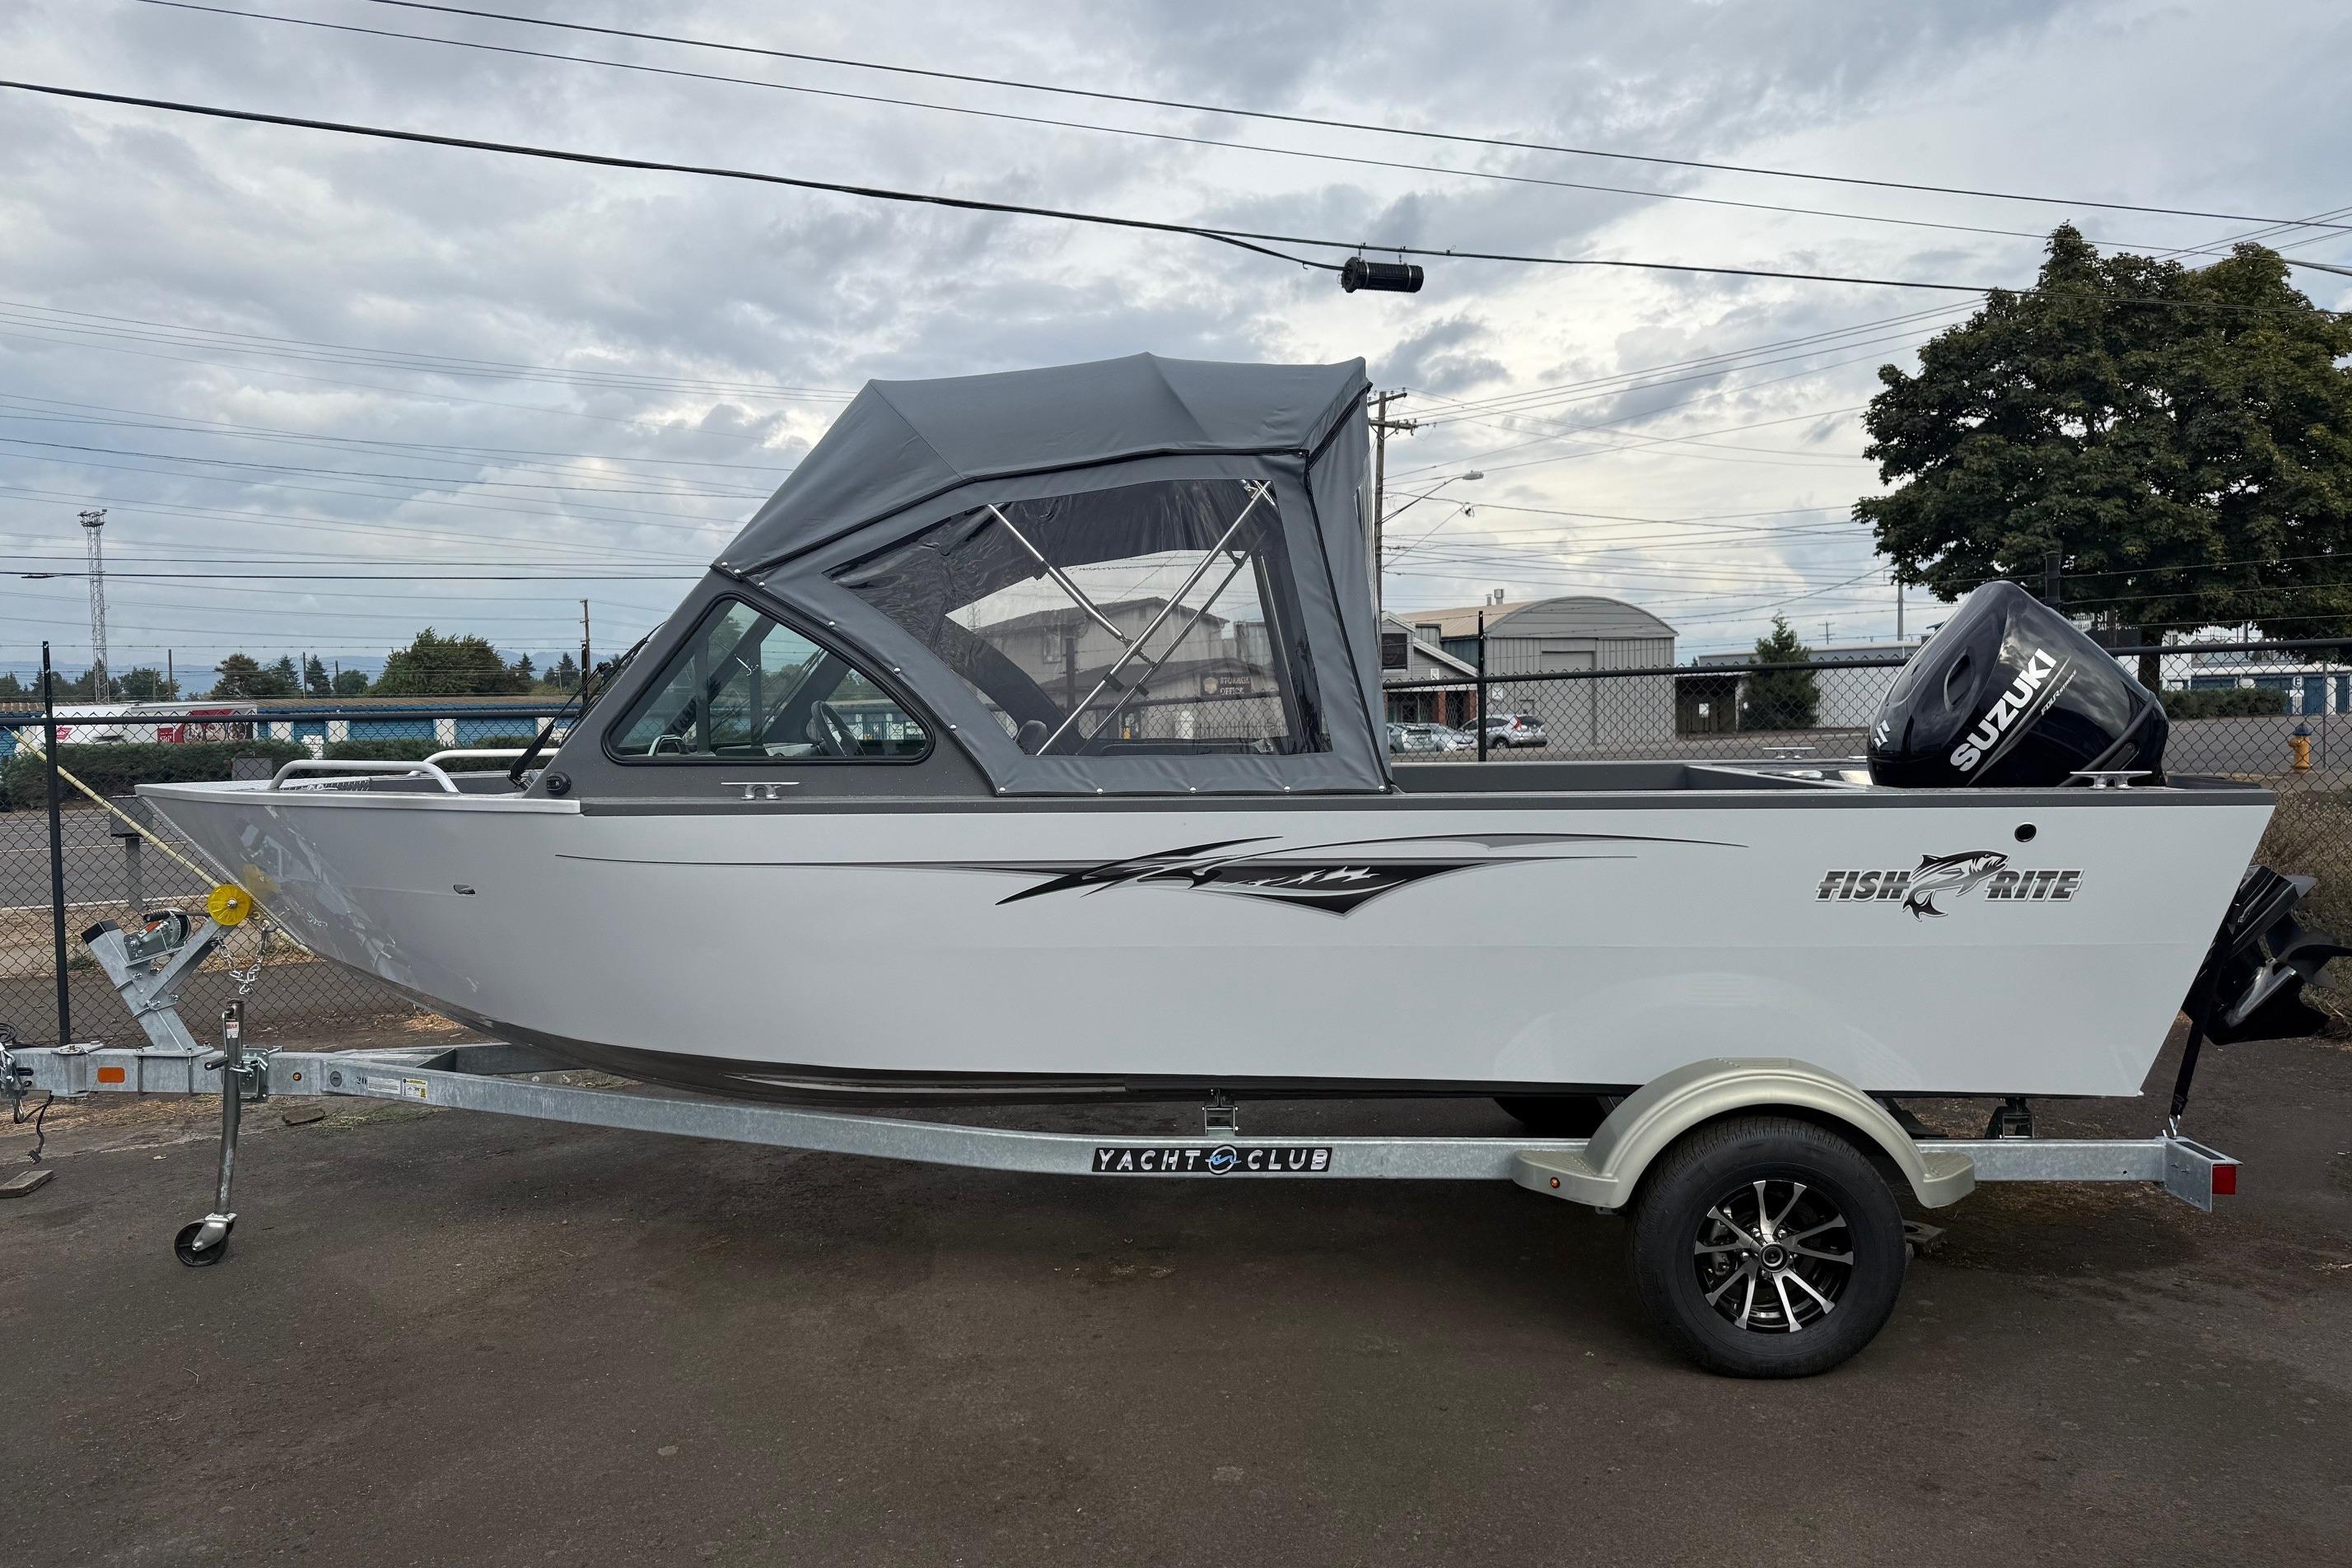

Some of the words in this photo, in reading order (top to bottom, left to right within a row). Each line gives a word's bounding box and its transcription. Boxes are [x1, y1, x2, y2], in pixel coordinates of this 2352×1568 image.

[1949, 647, 2057, 772] SUZUKI
[1815, 869, 1911, 903] FISH
[1984, 869, 2084, 903] RITE
[1098, 1149, 1201, 1171] YACHT
[1247, 1149, 1329, 1171] CLUB
